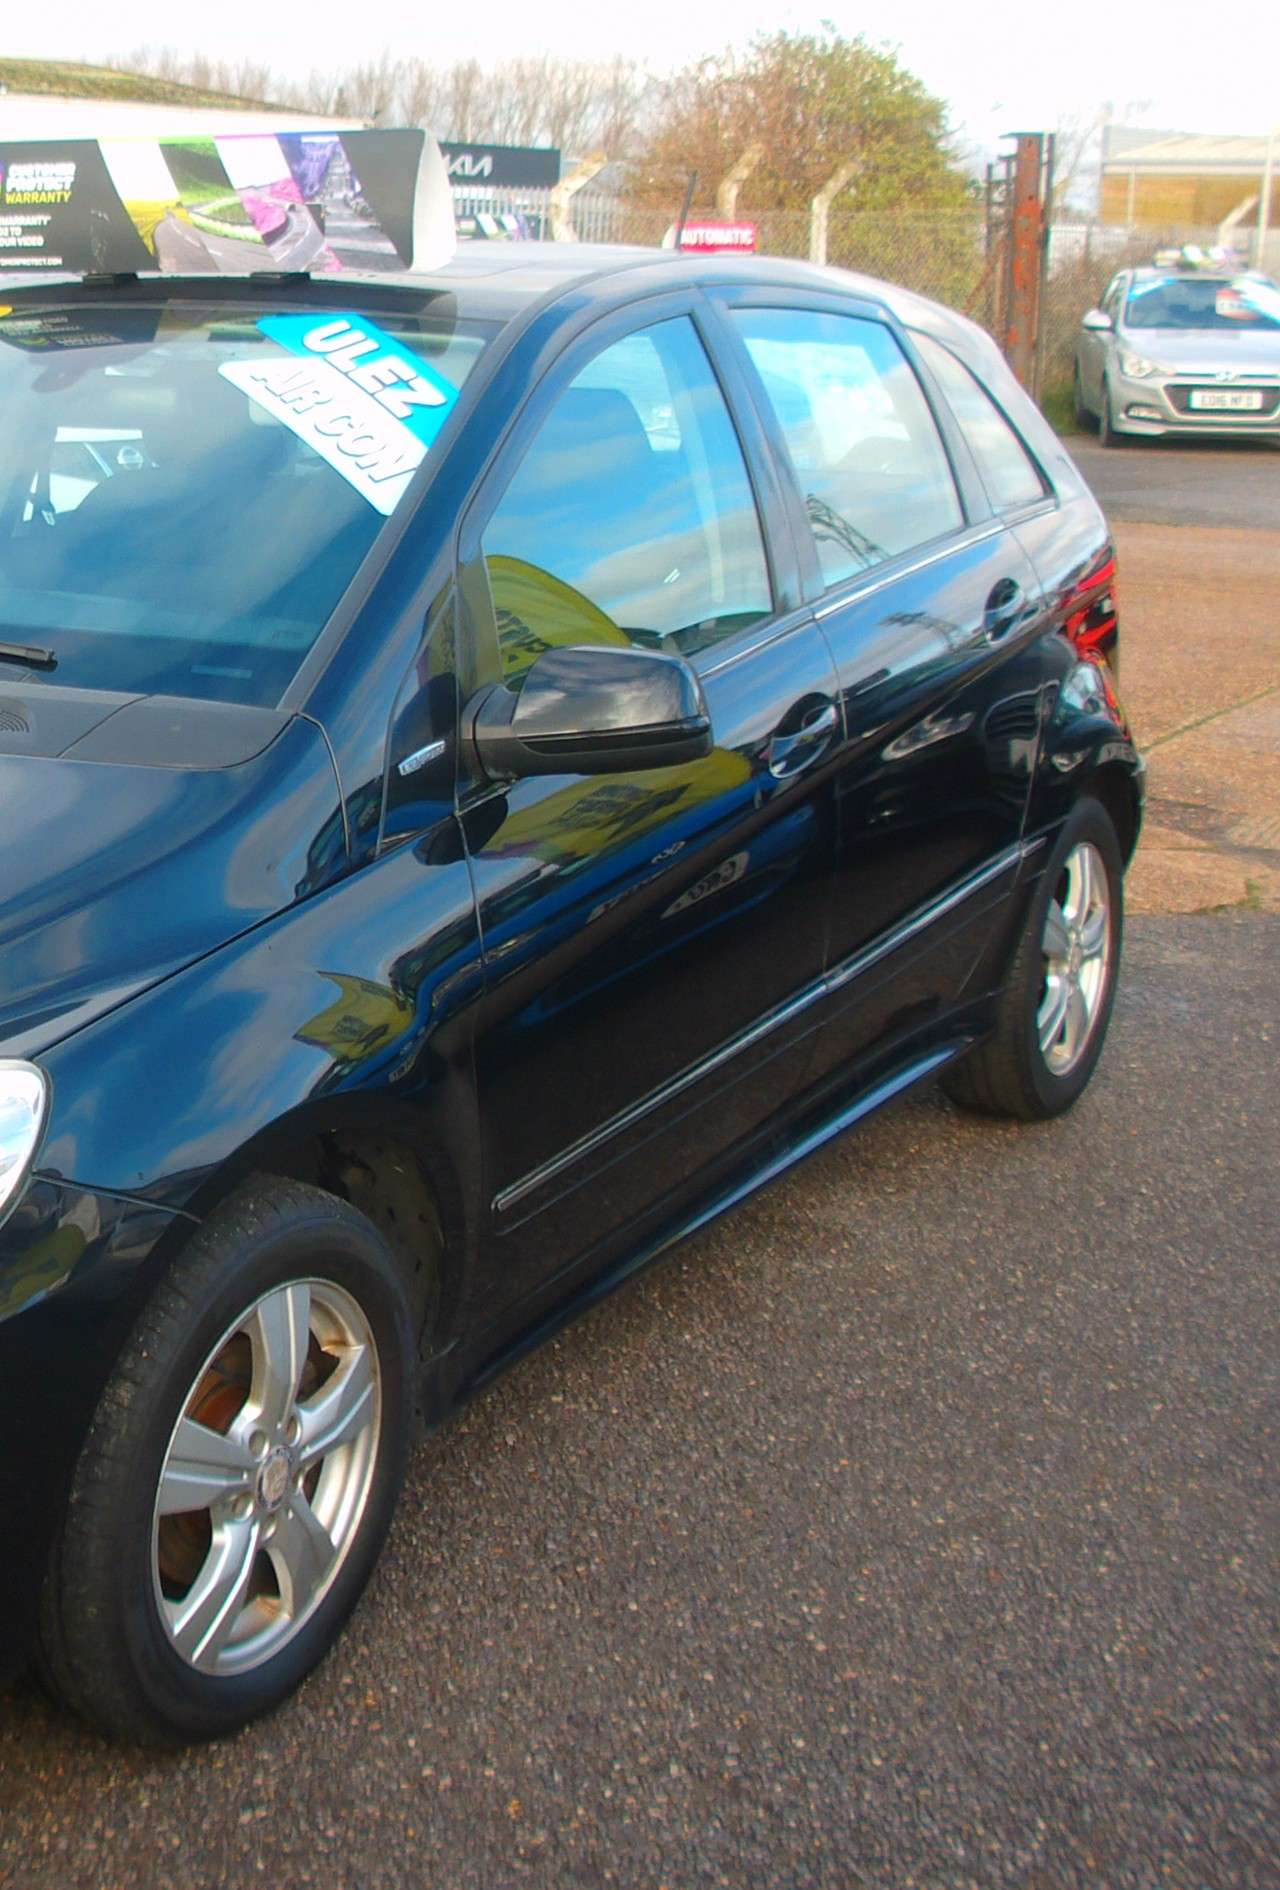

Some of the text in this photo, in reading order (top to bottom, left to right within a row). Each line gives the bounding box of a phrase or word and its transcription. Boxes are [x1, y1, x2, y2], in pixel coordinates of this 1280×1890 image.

[5, 176, 75, 192] PROTECT
[5, 191, 72, 204] WARRANTY
[17, 236, 44, 247] VIDEO
[680, 228, 754, 245] AUTOMATIC
[302, 319, 449, 420] ULEZ
[248, 366, 420, 484] AIR CON
